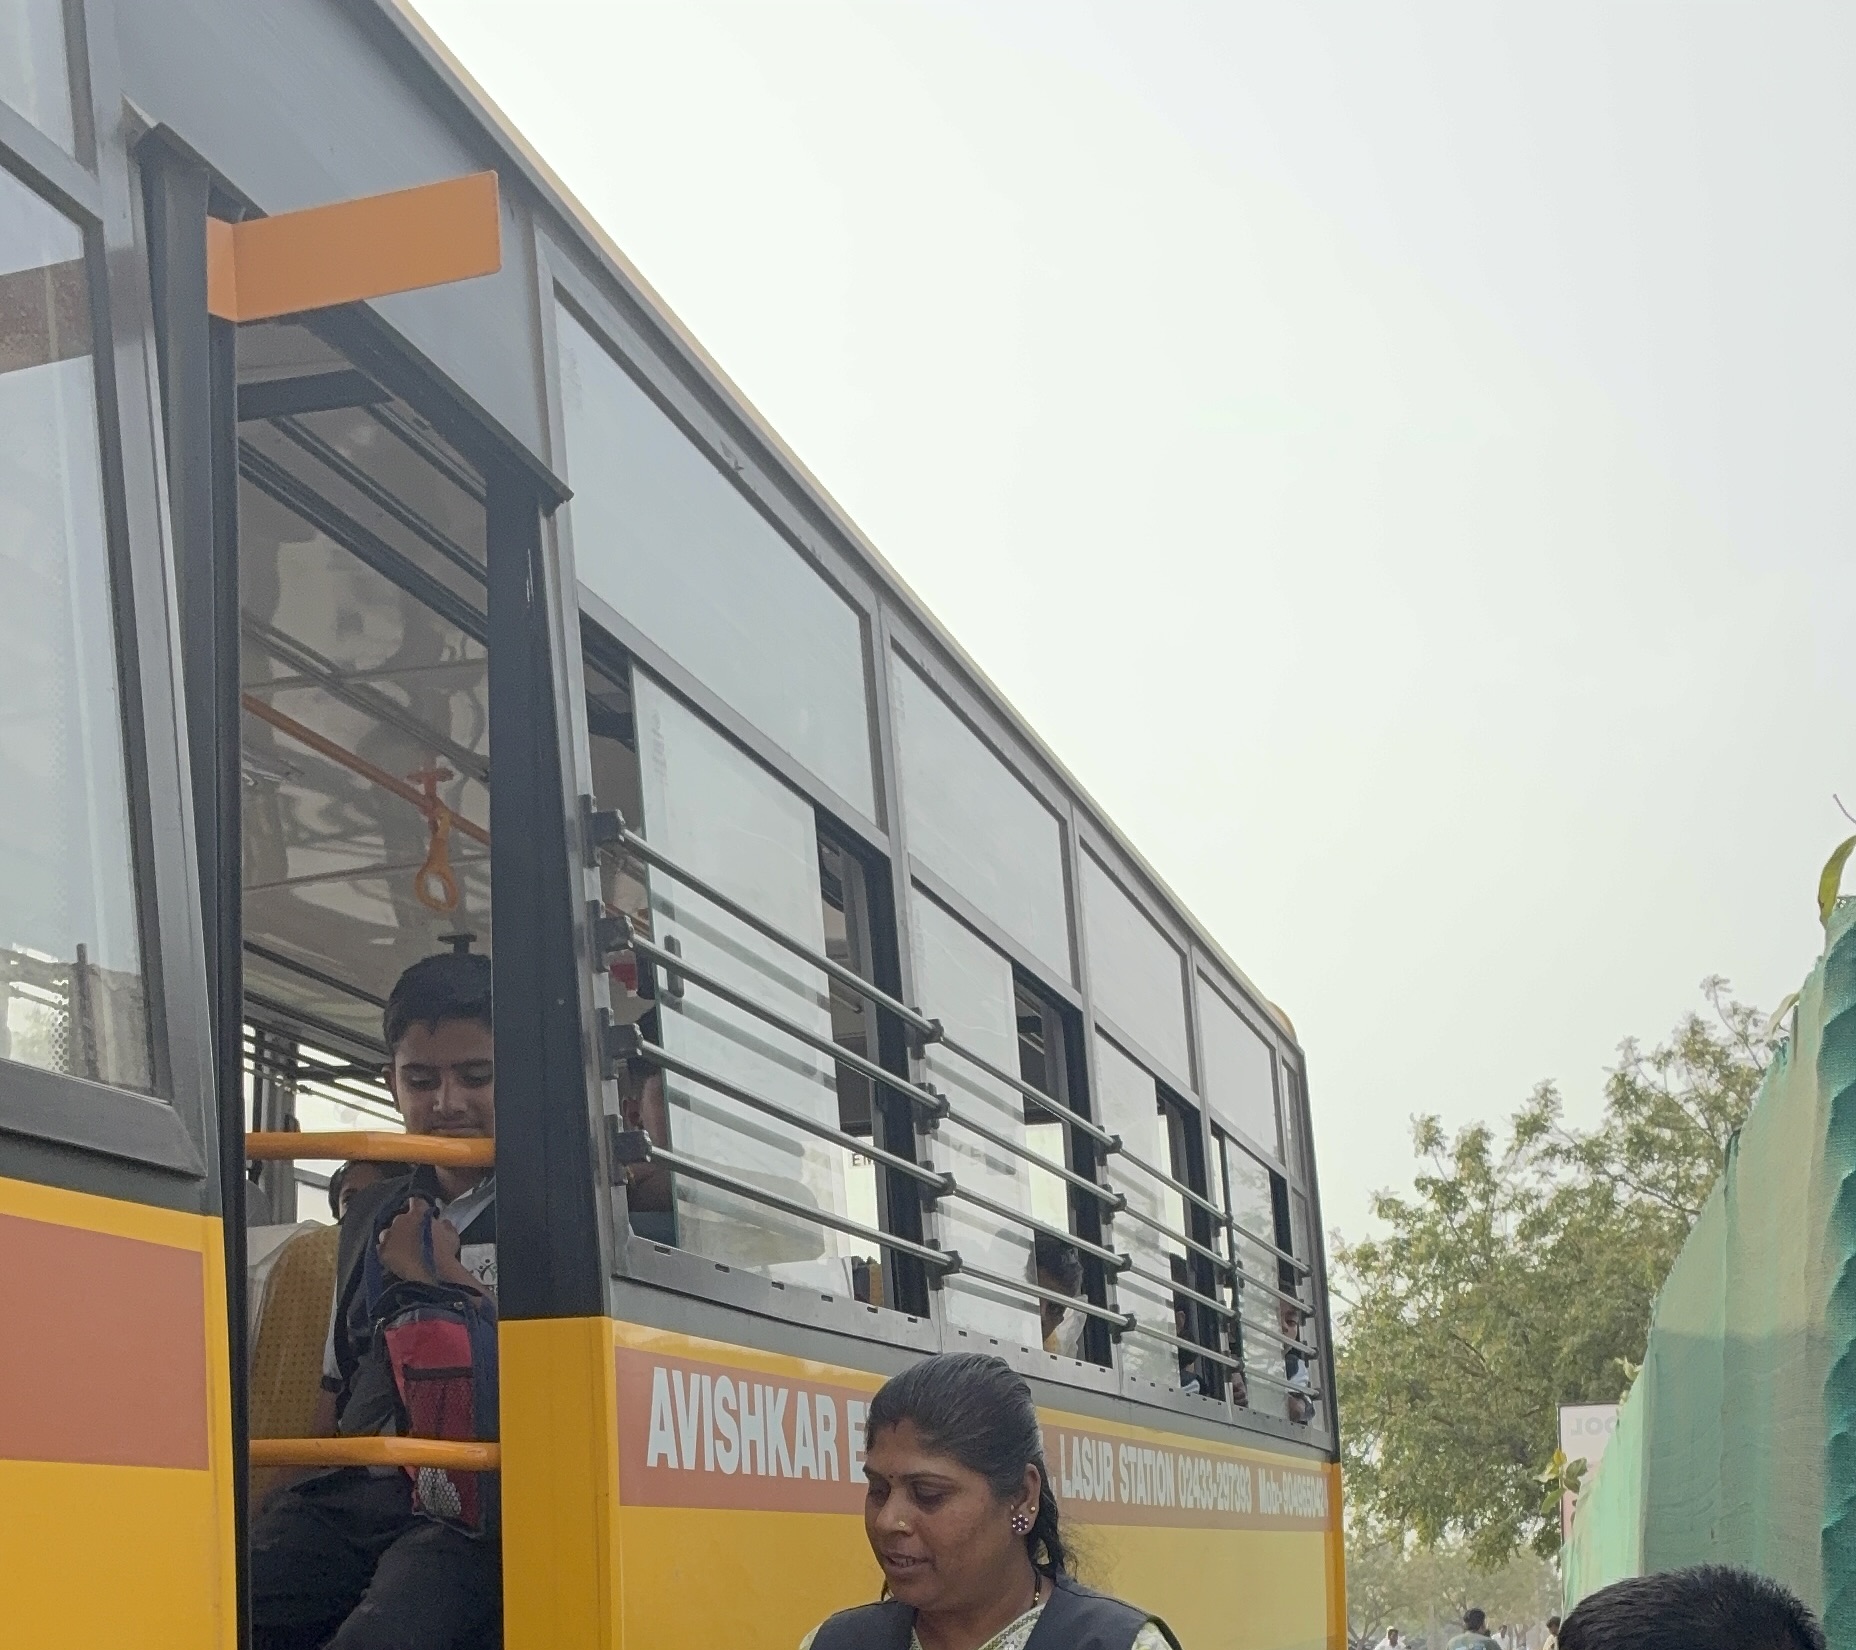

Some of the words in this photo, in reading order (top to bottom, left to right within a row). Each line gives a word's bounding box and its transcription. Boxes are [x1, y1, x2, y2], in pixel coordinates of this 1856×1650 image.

[647, 1366, 840, 1482] AVISHKAR
[847, 1400, 872, 1484] E
[1060, 1434, 1115, 1502] LASUR
[1119, 1442, 1176, 1508] STATION
